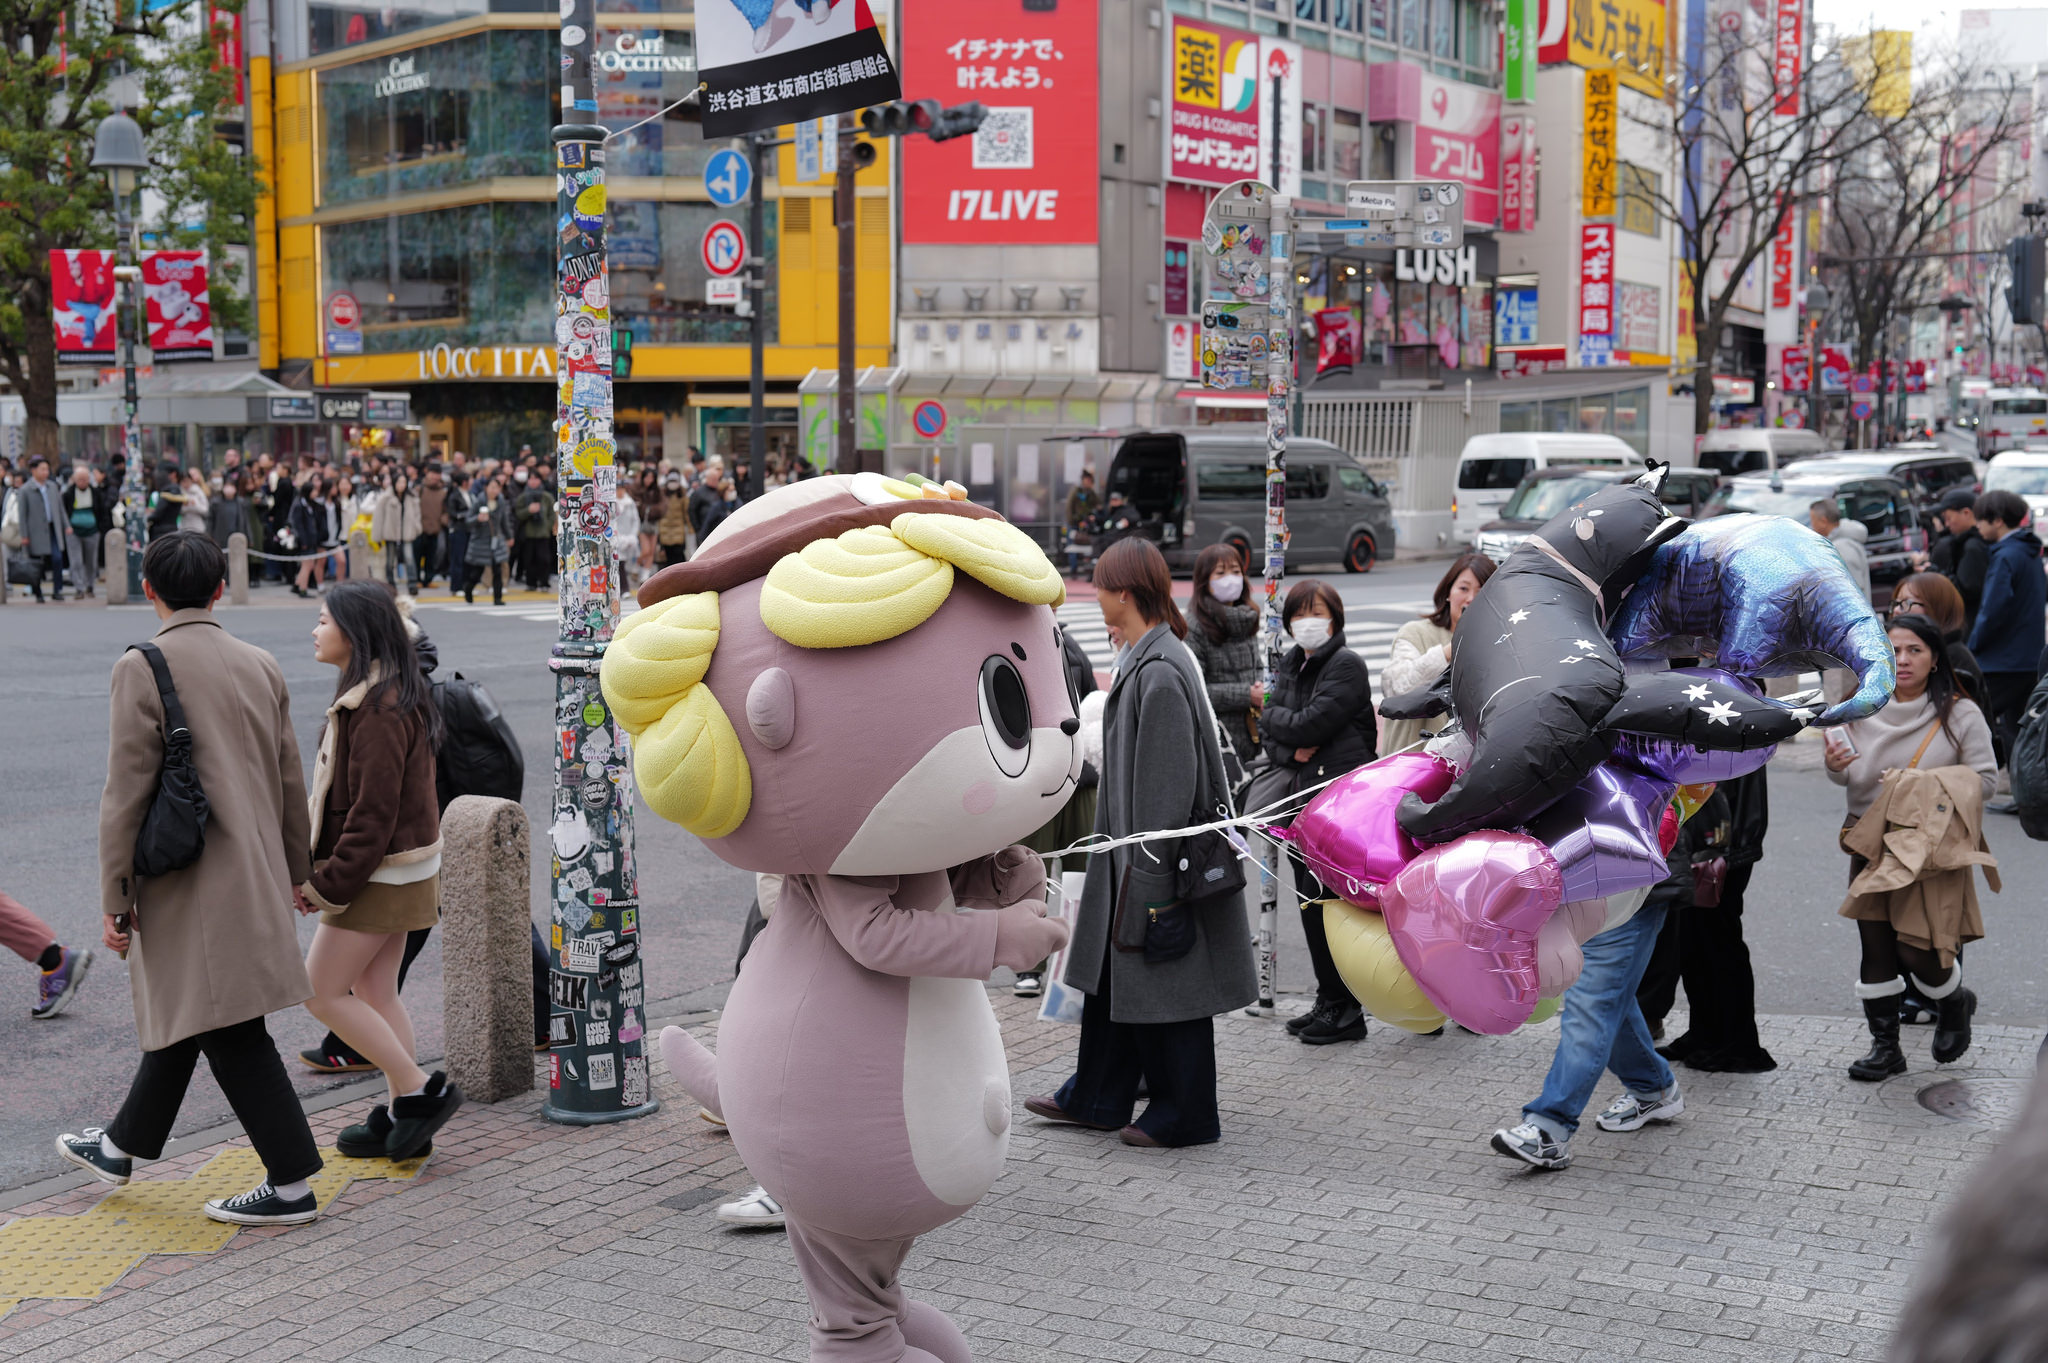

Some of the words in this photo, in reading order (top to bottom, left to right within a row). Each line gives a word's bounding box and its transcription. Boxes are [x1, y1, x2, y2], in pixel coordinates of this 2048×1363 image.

[946, 38, 1065, 61] イチナナで、
[1180, 36, 1216, 99] 薬
[708, 53, 890, 113] 渋谷道玄坂商店街振興組合
[956, 66, 1055, 90] 叶えよう。
[1173, 109, 1202, 131] DRUG
[1203, 115, 1211, 132] &
[1211, 116, 1258, 139] COSMETIC
[1430, 135, 1485, 181] アコム
[947, 189, 1059, 221] 17LIVE
[1395, 246, 1477, 287] LUSH
[1581, 227, 1613, 335] スギ薬局
[419, 342, 558, 380] L'OCCITA
